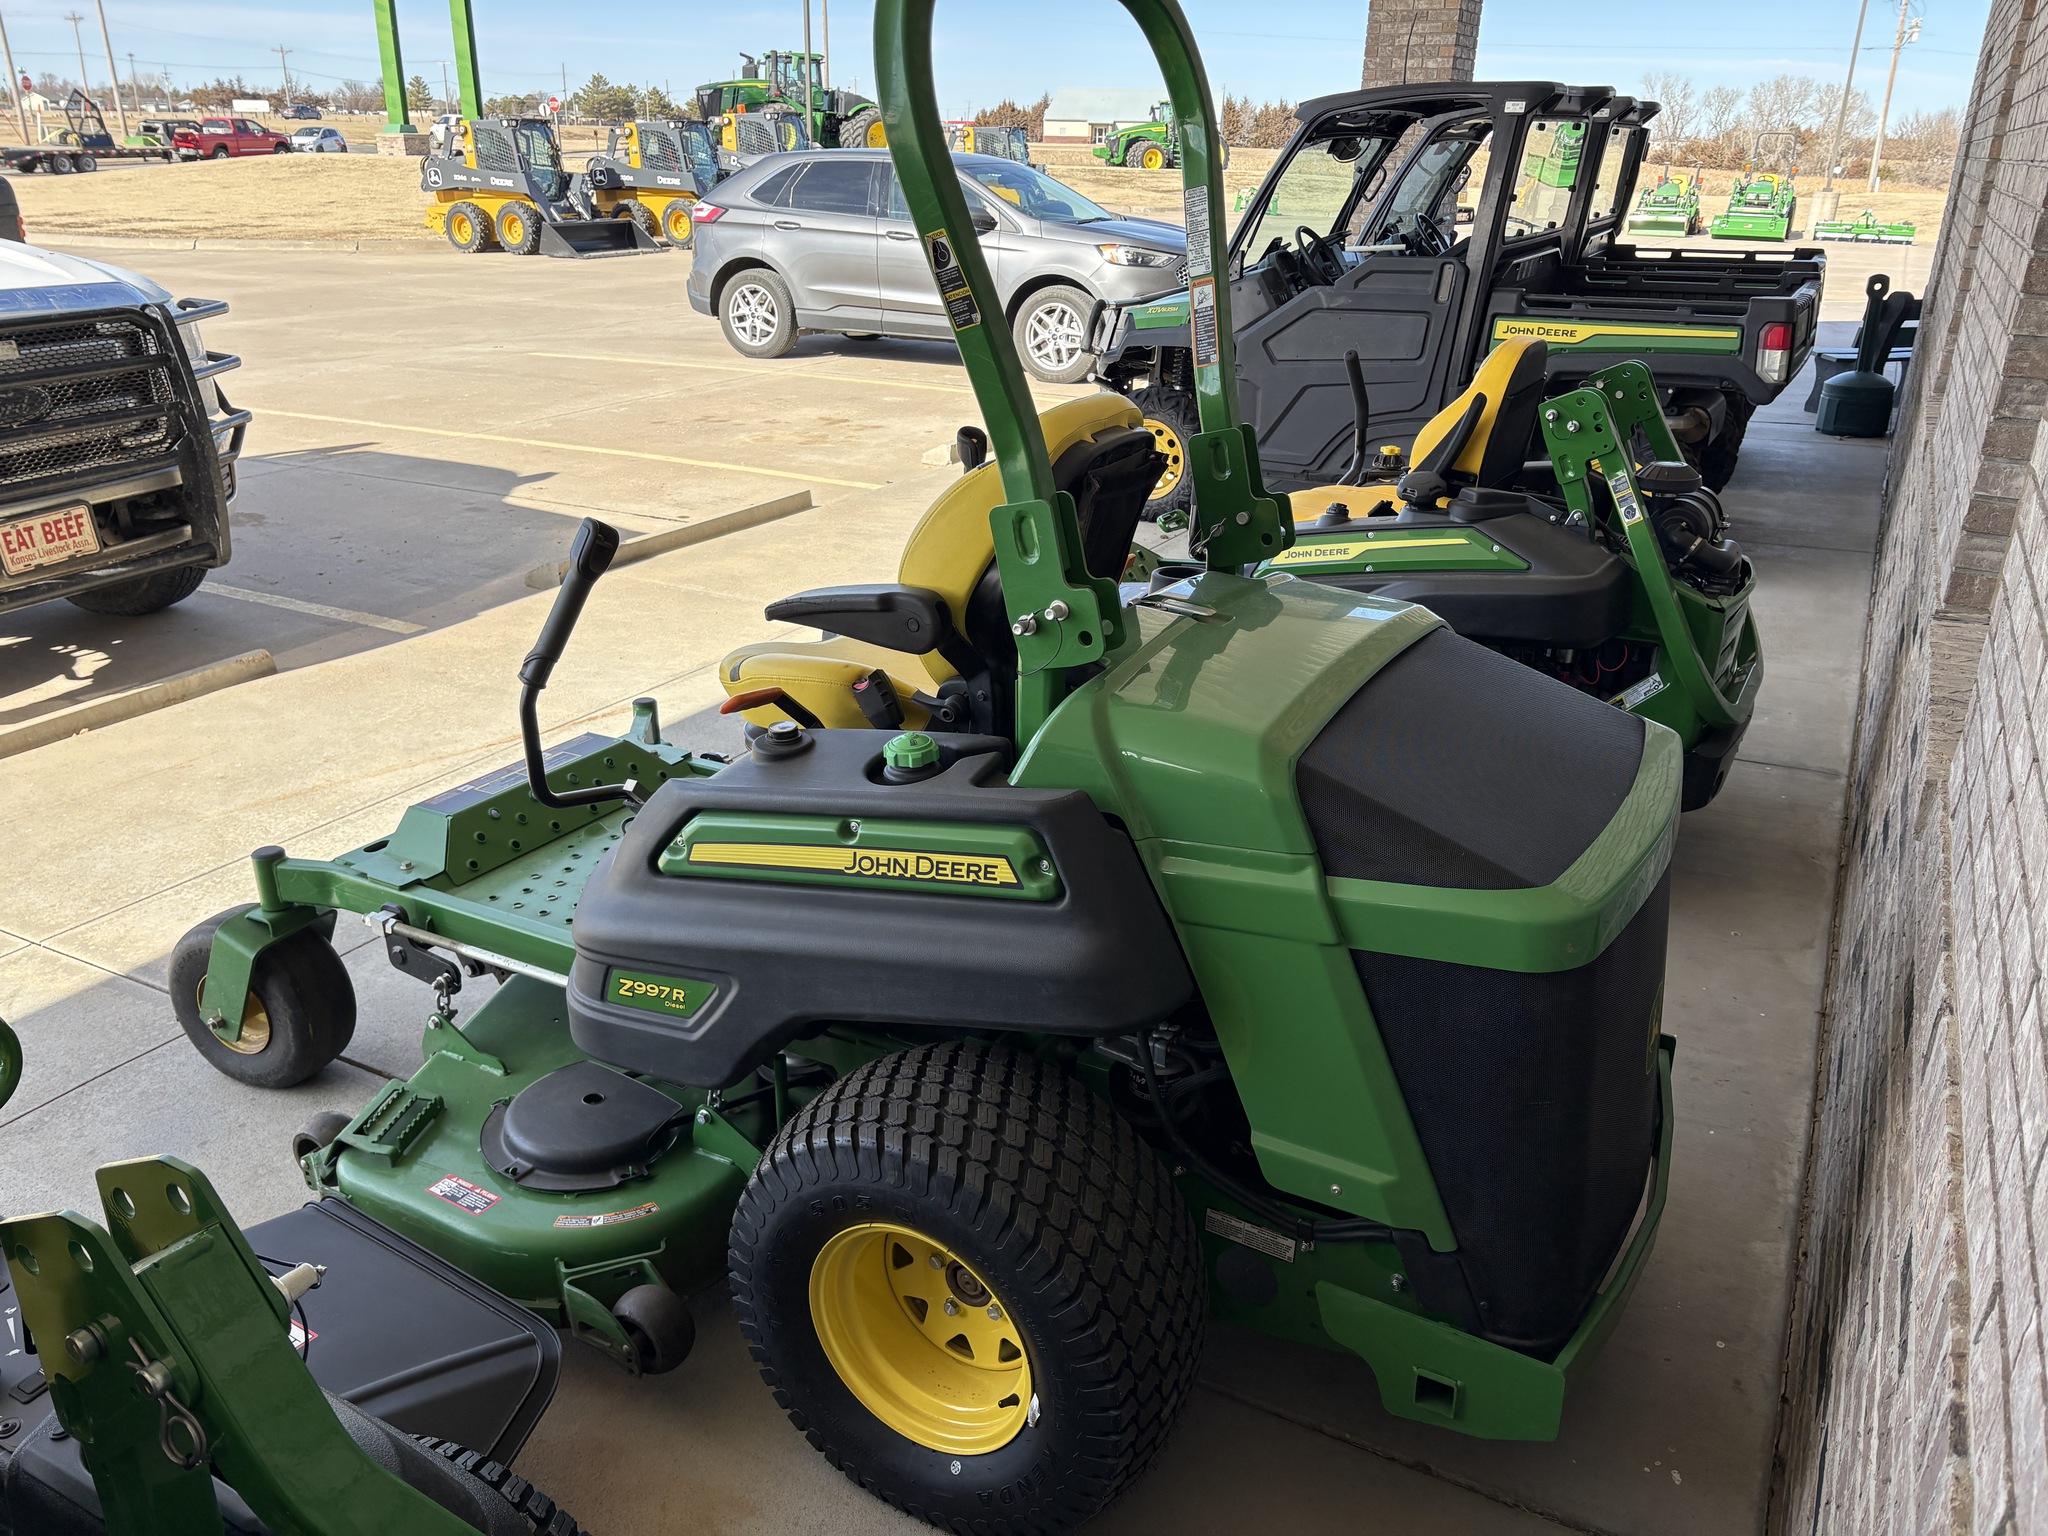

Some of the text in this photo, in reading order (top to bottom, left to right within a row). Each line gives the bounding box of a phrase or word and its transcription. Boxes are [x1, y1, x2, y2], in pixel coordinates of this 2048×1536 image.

[490, 176, 514, 187] DEERE
[657, 175, 681, 185] DEERE
[1502, 325, 1577, 338] JOHN DEERE
[1, 513, 85, 555] EAT BEEF
[9, 539, 93, 566] Kansas Livestock Assn.
[1284, 548, 1350, 559] JOHN DEERE
[844, 852, 999, 882] JOHN DEERE
[618, 978, 685, 1002] Z997R
[664, 1000, 686, 1010] Diesel
[809, 1194, 873, 1217] 505
[976, 1442, 1059, 1510] KENDA
